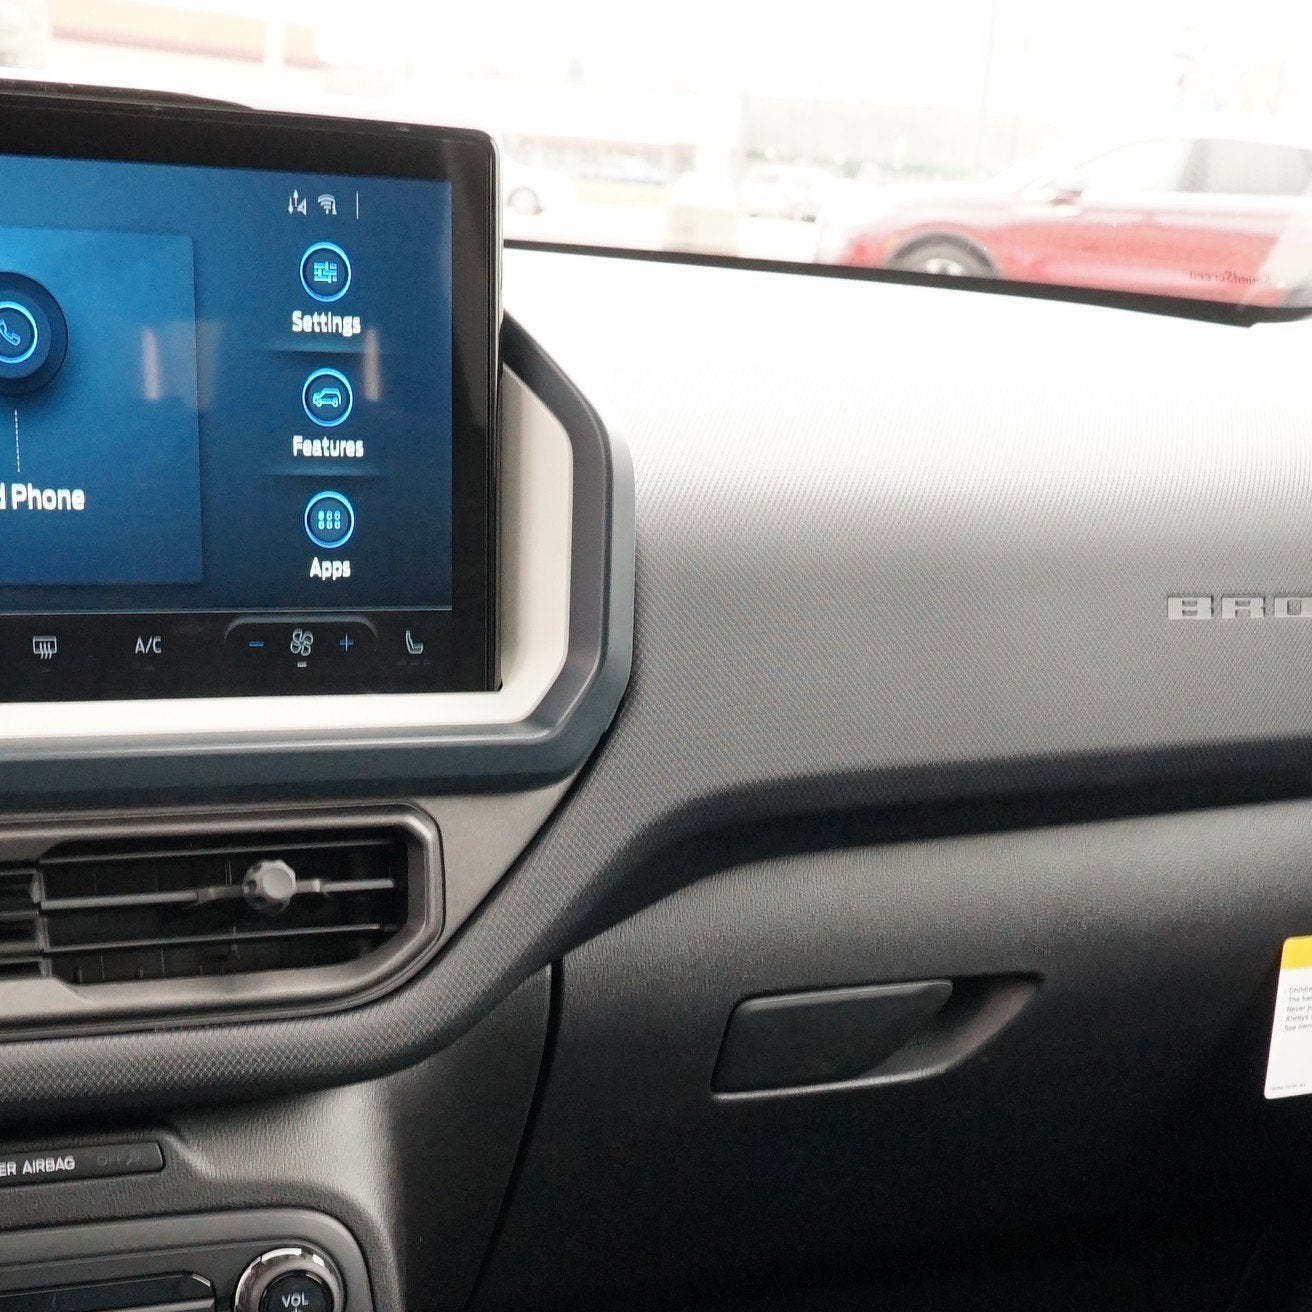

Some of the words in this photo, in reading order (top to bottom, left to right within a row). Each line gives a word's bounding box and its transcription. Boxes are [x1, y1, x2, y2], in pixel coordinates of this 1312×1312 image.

[292, 310, 361, 337] Settings
[292, 435, 364, 458] Features
[11, 482, 85, 511] Phone
[309, 556, 351, 580] Apps
[134, 635, 162, 654] A/C
[22, 1155, 75, 1175] AIRBAG
[281, 1292, 309, 1308] VOL
